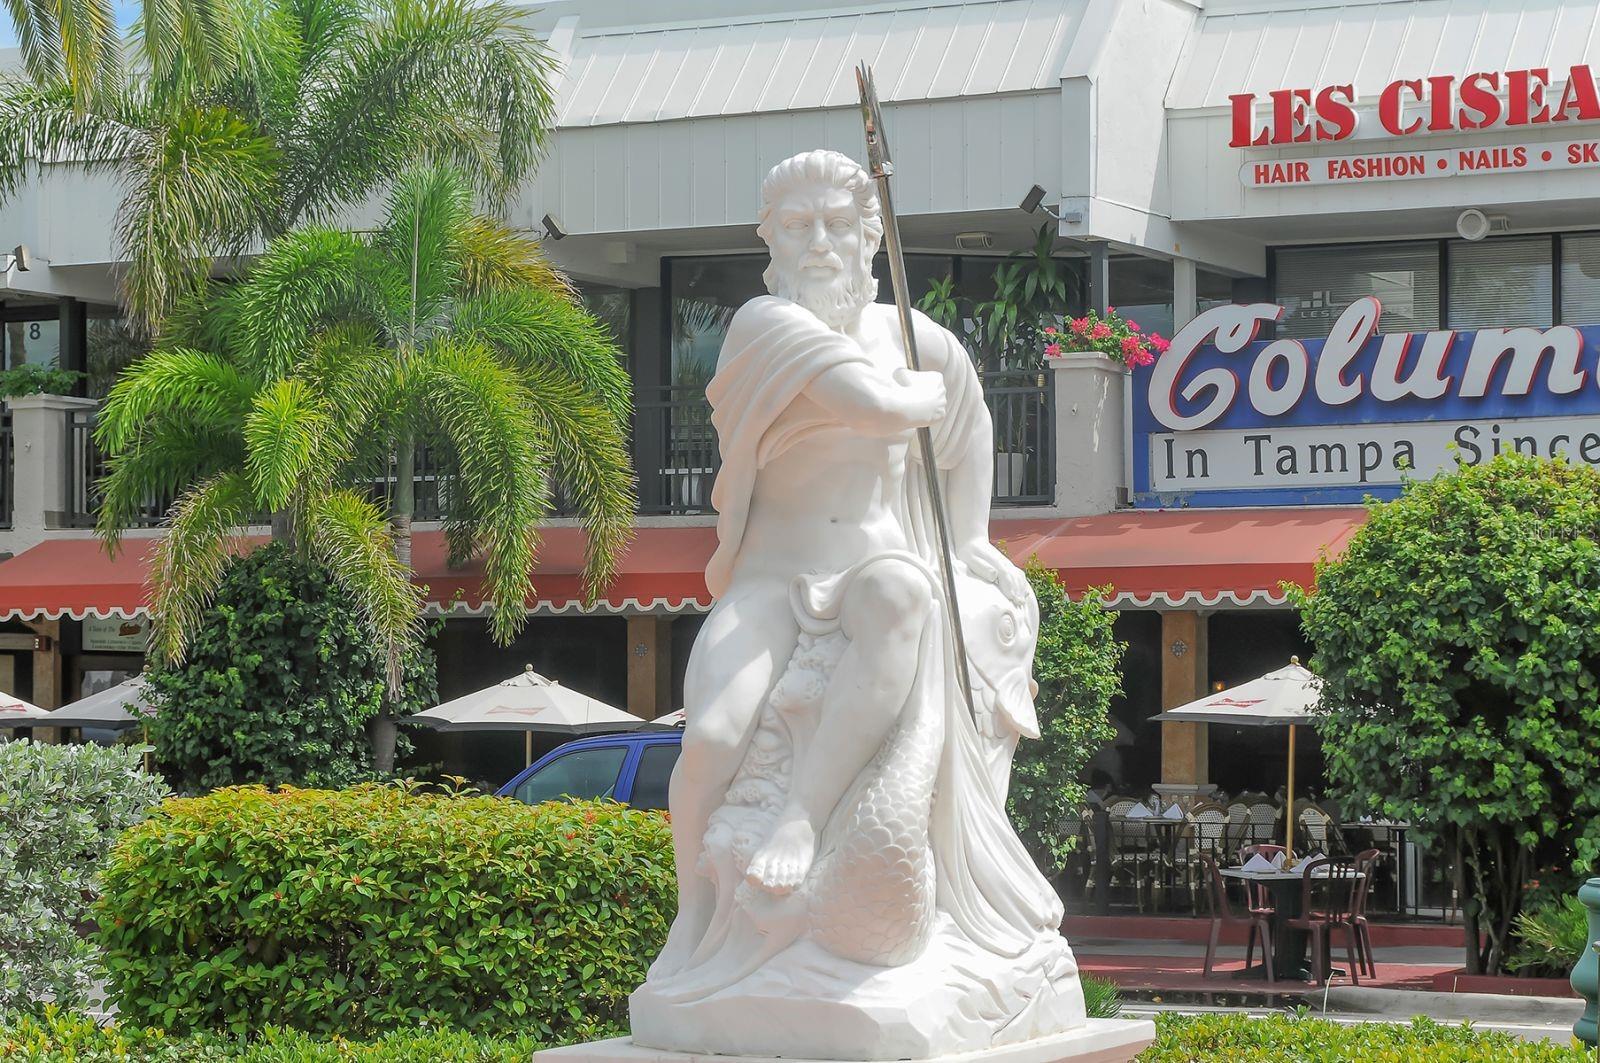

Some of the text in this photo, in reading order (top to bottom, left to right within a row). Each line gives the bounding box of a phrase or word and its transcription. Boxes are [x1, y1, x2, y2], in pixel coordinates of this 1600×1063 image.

[1228, 84, 1356, 148] LES
[1254, 142, 1600, 184] HAIR FASHION NAILS SK
[29, 322, 41, 340] 8
[1148, 296, 1600, 431] Colum
[1164, 424, 1600, 483] In Tampa Since
